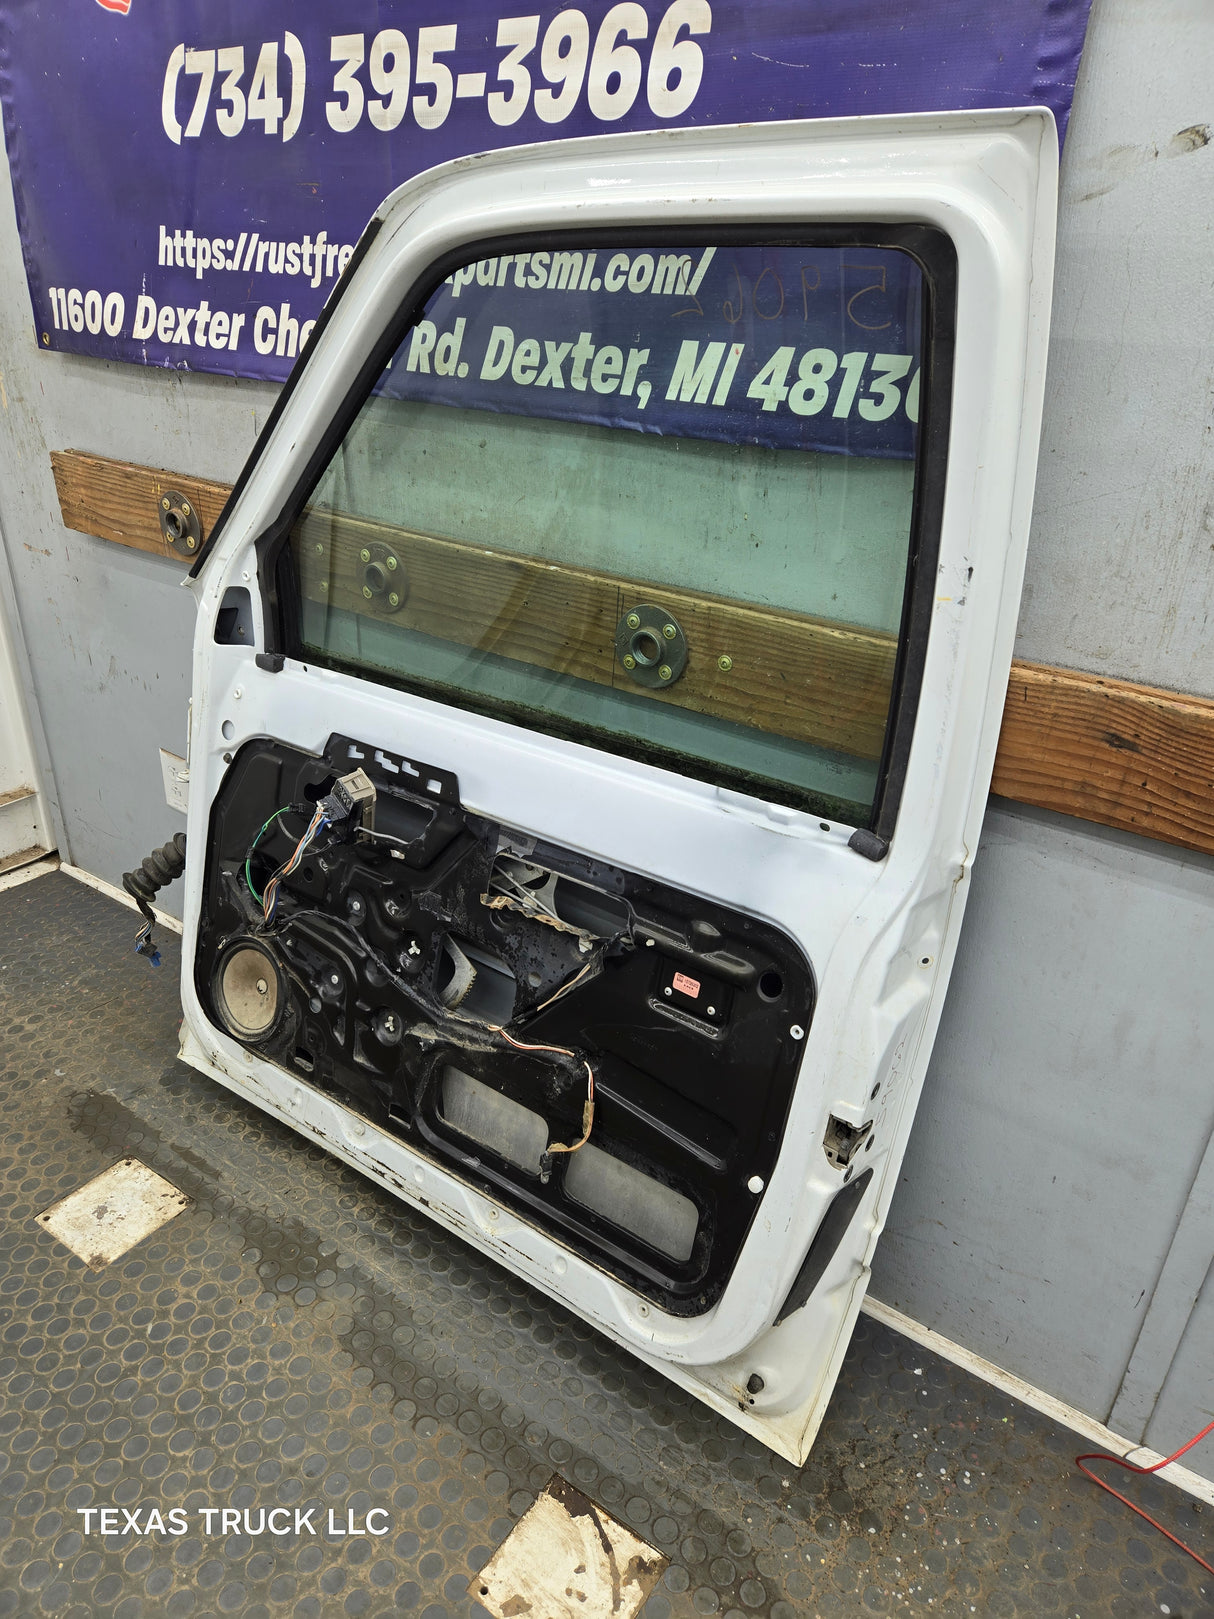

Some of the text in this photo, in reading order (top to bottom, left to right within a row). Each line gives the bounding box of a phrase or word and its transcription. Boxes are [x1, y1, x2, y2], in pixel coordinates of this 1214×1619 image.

[161, 0, 712, 145] (734) 395-3966
[158, 225, 718, 297] https://rustfre partsmi.com/
[48, 286, 125, 337] 11600
[132, 295, 246, 351] Dexter
[406, 317, 469, 378] Rd.
[479, 326, 652, 409] Dexter,
[665, 340, 745, 406] MI
